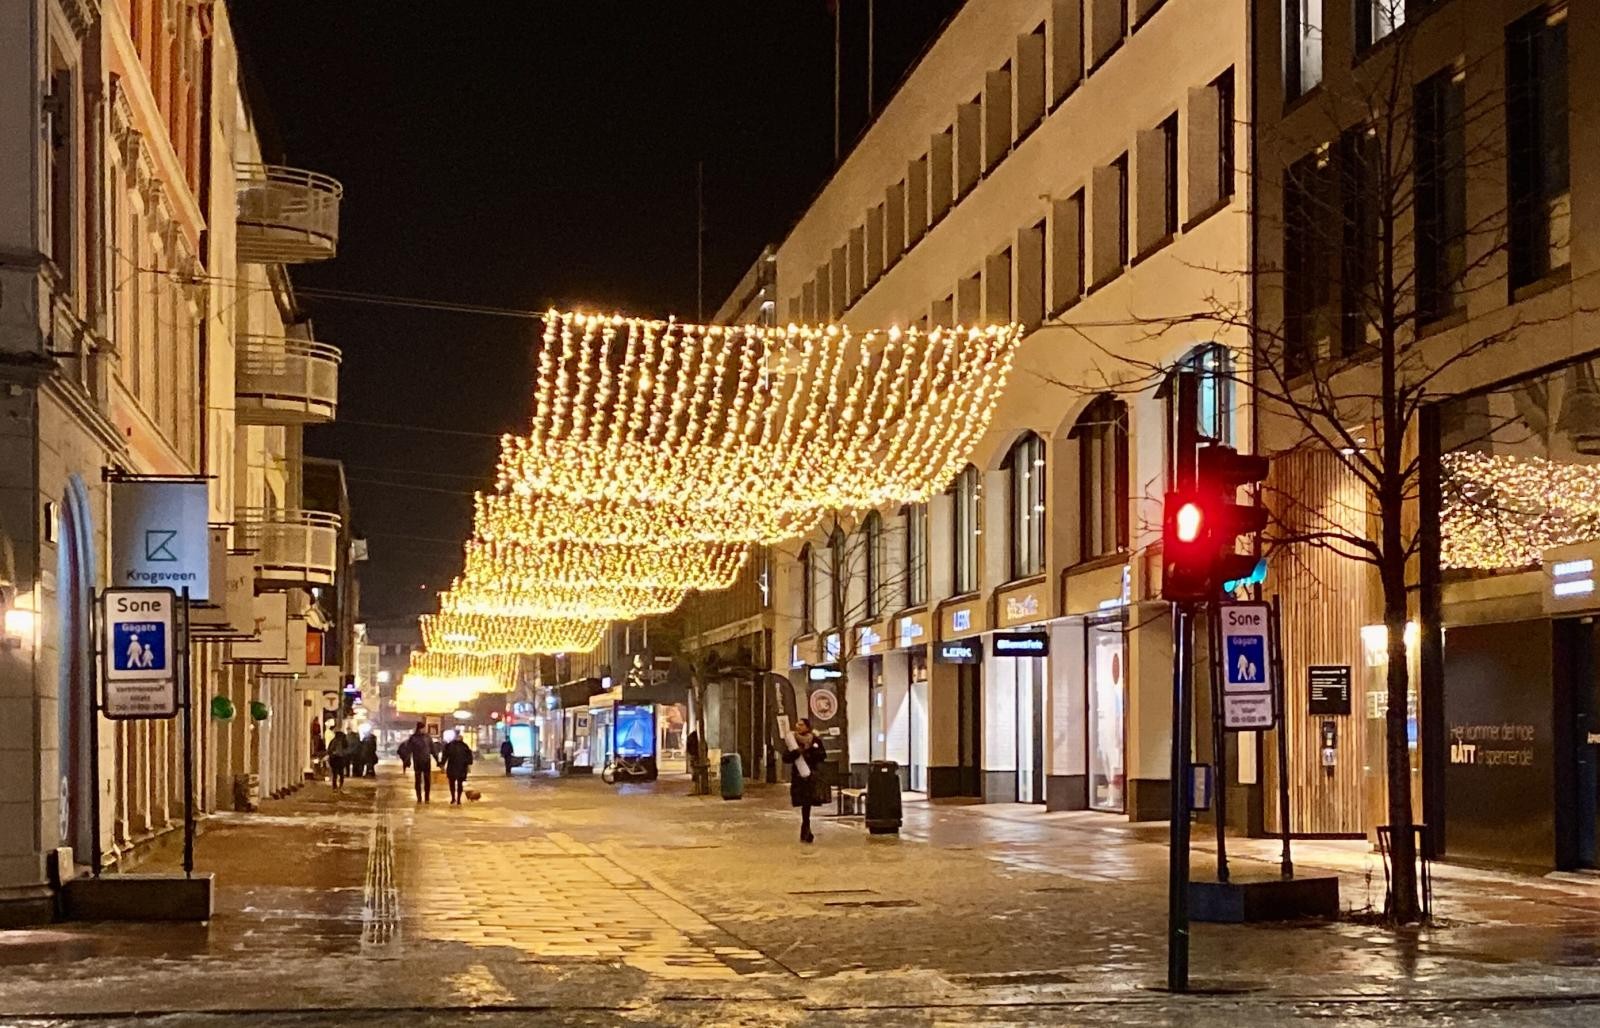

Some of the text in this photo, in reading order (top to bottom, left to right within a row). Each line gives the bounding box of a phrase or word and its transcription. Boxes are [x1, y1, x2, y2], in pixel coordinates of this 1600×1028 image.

[126, 569, 196, 584] Krogsveen
[117, 597, 162, 612] Sone
[1228, 610, 1261, 626] Sone
[942, 647, 973, 657] LERK
